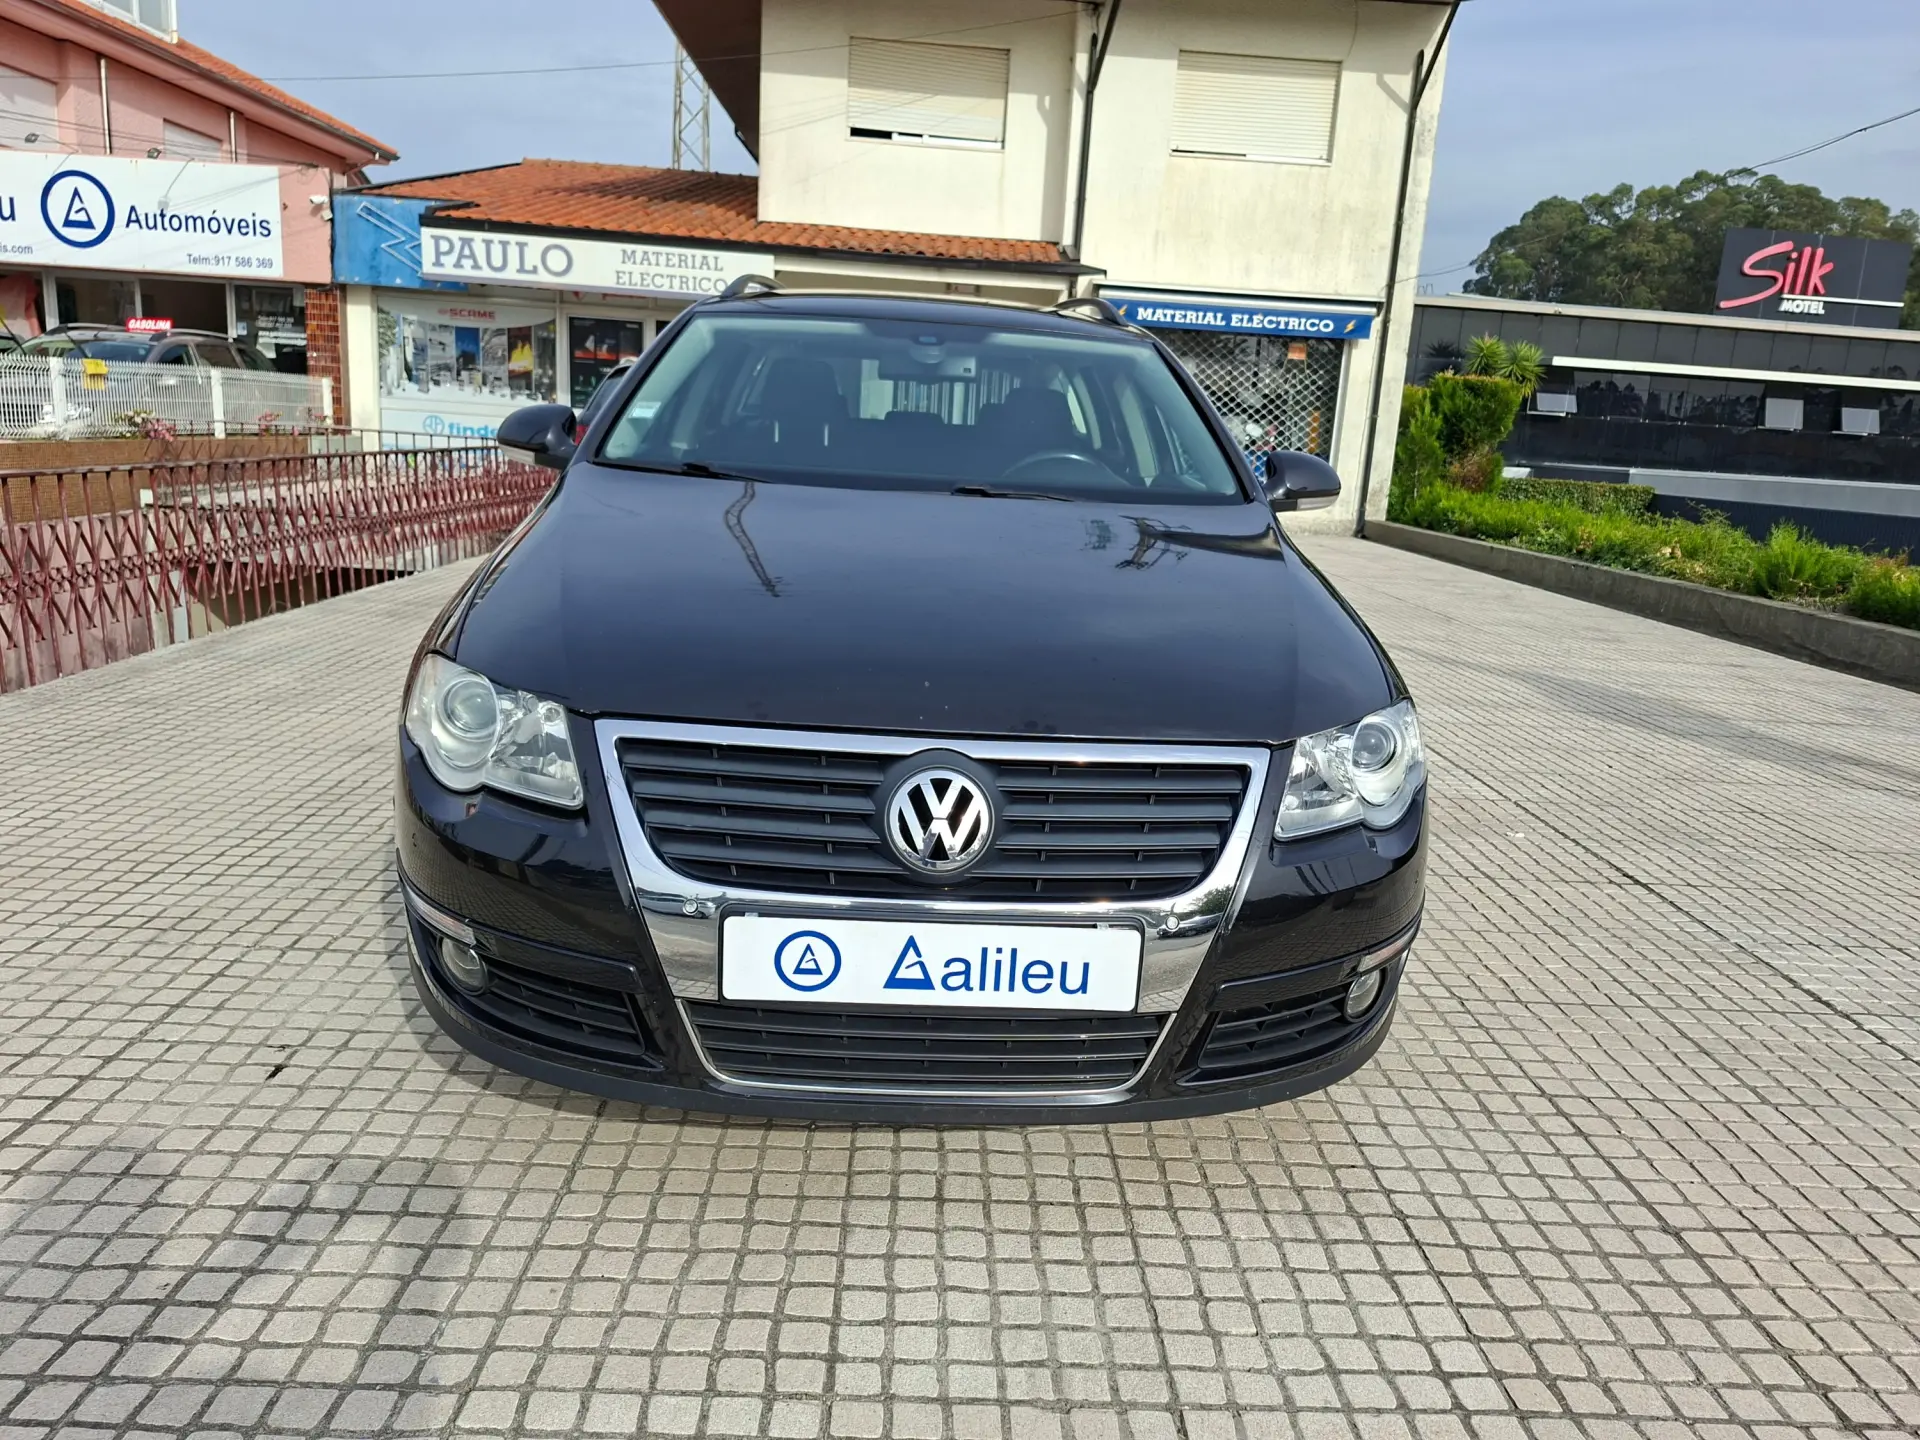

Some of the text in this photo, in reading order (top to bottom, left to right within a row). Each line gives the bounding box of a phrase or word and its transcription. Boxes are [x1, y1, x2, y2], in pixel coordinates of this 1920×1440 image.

[125, 205, 272, 238] Automóveis
[235, 256, 253, 269] 586
[255, 257, 274, 270] 369
[430, 234, 574, 278] PAULO
[620, 249, 724, 272] MATERIAL
[1719, 240, 1834, 310] Silk
[449, 308, 497, 321] SCAME
[1136, 307, 1226, 327] MATERIAL
[1778, 300, 1825, 315] MOTEL
[127, 318, 172, 330] GASOLINA
